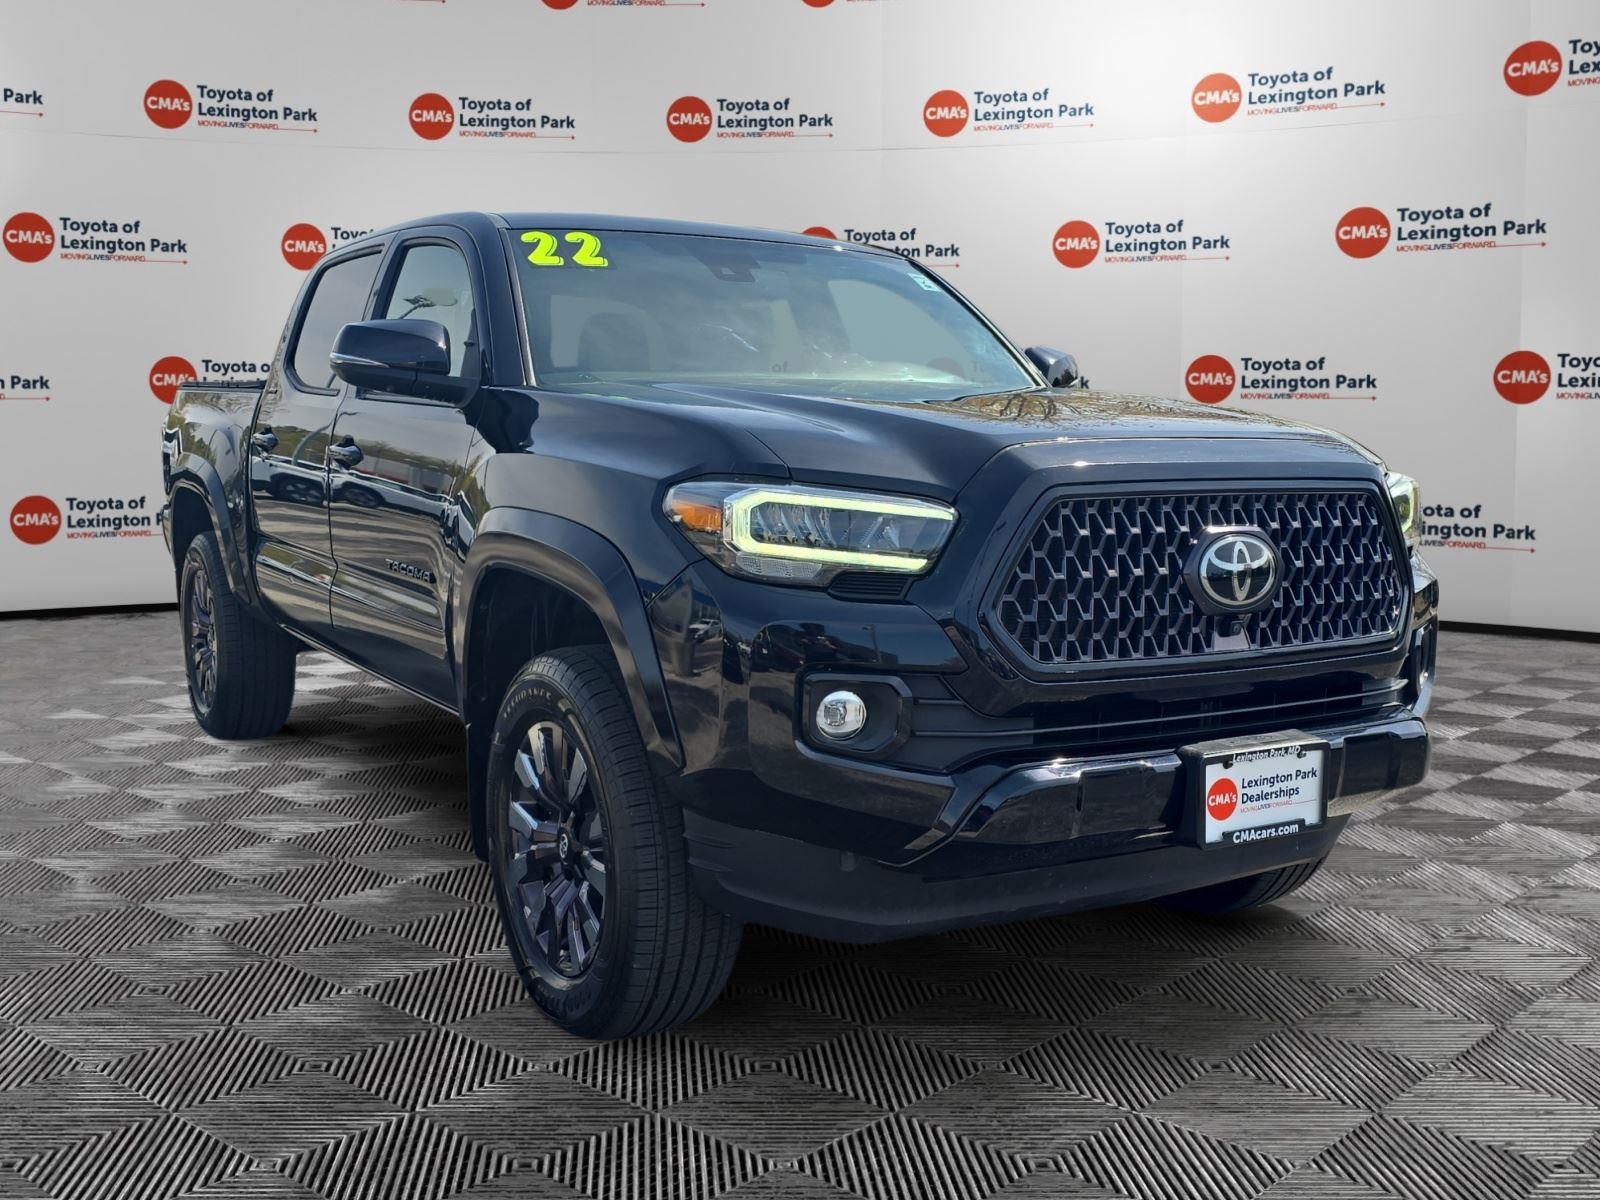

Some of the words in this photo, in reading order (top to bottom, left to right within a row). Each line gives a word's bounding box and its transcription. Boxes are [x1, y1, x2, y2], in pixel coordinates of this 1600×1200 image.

[1508, 59, 1559, 77] CMA's
[1248, 71, 1309, 89] Toyota
[1313, 67, 1333, 80] of
[3, 88, 43, 105] Park
[197, 85, 252, 102] Toyota
[257, 90, 273, 102] of
[974, 90, 1028, 107] Toyota
[1032, 88, 1049, 101] of
[1194, 89, 1240, 106] CMA's
[1248, 86, 1337, 105] Lexington
[1344, 80, 1386, 97] Park
[147, 96, 190, 111] CMA's
[198, 102, 278, 121] Lexington
[283, 107, 317, 121] Park
[459, 97, 511, 113] Toyota
[515, 99, 532, 111] of
[717, 99, 769, 114] Toyota
[773, 98, 790, 111] of
[412, 109, 452, 123] CMA's
[669, 112, 710, 125] CMA's
[925, 106, 967, 120] CMA's
[975, 107, 1053, 122] Lexington
[1058, 103, 1094, 117] Park
[459, 114, 536, 131] Lexington
[540, 116, 575, 129] Park
[717, 115, 794, 131] Lexington
[799, 114, 833, 127] Park
[1397, 207, 1463, 224] Toyota
[1469, 203, 1492, 218] of
[60, 217, 118, 235] Toyota
[122, 221, 140, 234] of
[1105, 222, 1161, 238] Toyota
[1166, 220, 1184, 233] of
[1338, 224, 1388, 240] CMA's
[1397, 224, 1496, 242] Lexington
[1503, 219, 1546, 235] Park
[6, 229, 53, 245] CMA's
[60, 235, 146, 254] Lexington
[150, 239, 187, 253] Park
[844, 229, 896, 244] Toyota
[900, 228, 917, 241] of
[1055, 237, 1098, 251] CMA's
[1105, 239, 1187, 254] Lexington
[1192, 235, 1230, 250] Park
[284, 240, 325, 253] CMA's
[520, 231, 609, 267] 22
[925, 244, 960, 257] Park
[202, 359, 257, 376] Toyota
[1241, 357, 1301, 374] Toyota
[1305, 356, 1326, 371] of
[11, 375, 50, 390] Park
[1188, 372, 1233, 386] CMA's
[1241, 375, 1329, 392] Lexington
[1336, 374, 1377, 388] Park
[1497, 369, 1548, 384] CMA's
[66, 497, 124, 514] Toyota
[128, 496, 146, 509] of
[1460, 504, 1482, 518] of
[13, 512, 59, 527] CMA's
[67, 515, 150, 530] Lexington
[1493, 523, 1536, 540] Park
[385, 558, 432, 582] TACOMA
[1232, 752, 1269, 763] Lexington
[1288, 745, 1301, 755] MD
[1242, 772, 1293, 789] Lexington
[1295, 767, 1317, 780] Park
[1208, 793, 1237, 806] CMA's
[1242, 785, 1300, 804] Dealerships
[1233, 823, 1299, 844] CMAcars.com
